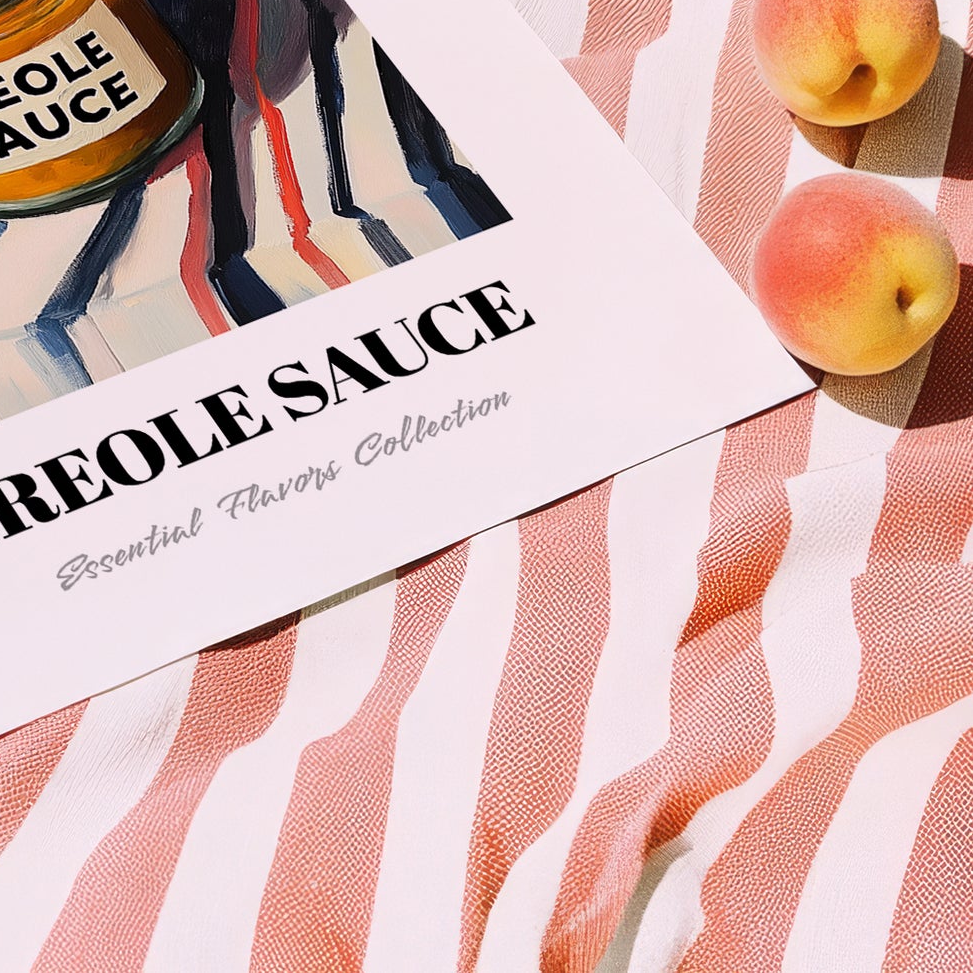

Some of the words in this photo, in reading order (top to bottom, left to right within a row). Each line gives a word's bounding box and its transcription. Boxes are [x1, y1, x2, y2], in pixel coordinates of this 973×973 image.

[267, 280, 536, 422] SAUCE
[56, 507, 204, 591] Essential
[216, 459, 343, 520] Flavors
[354, 390, 512, 467] Collection
